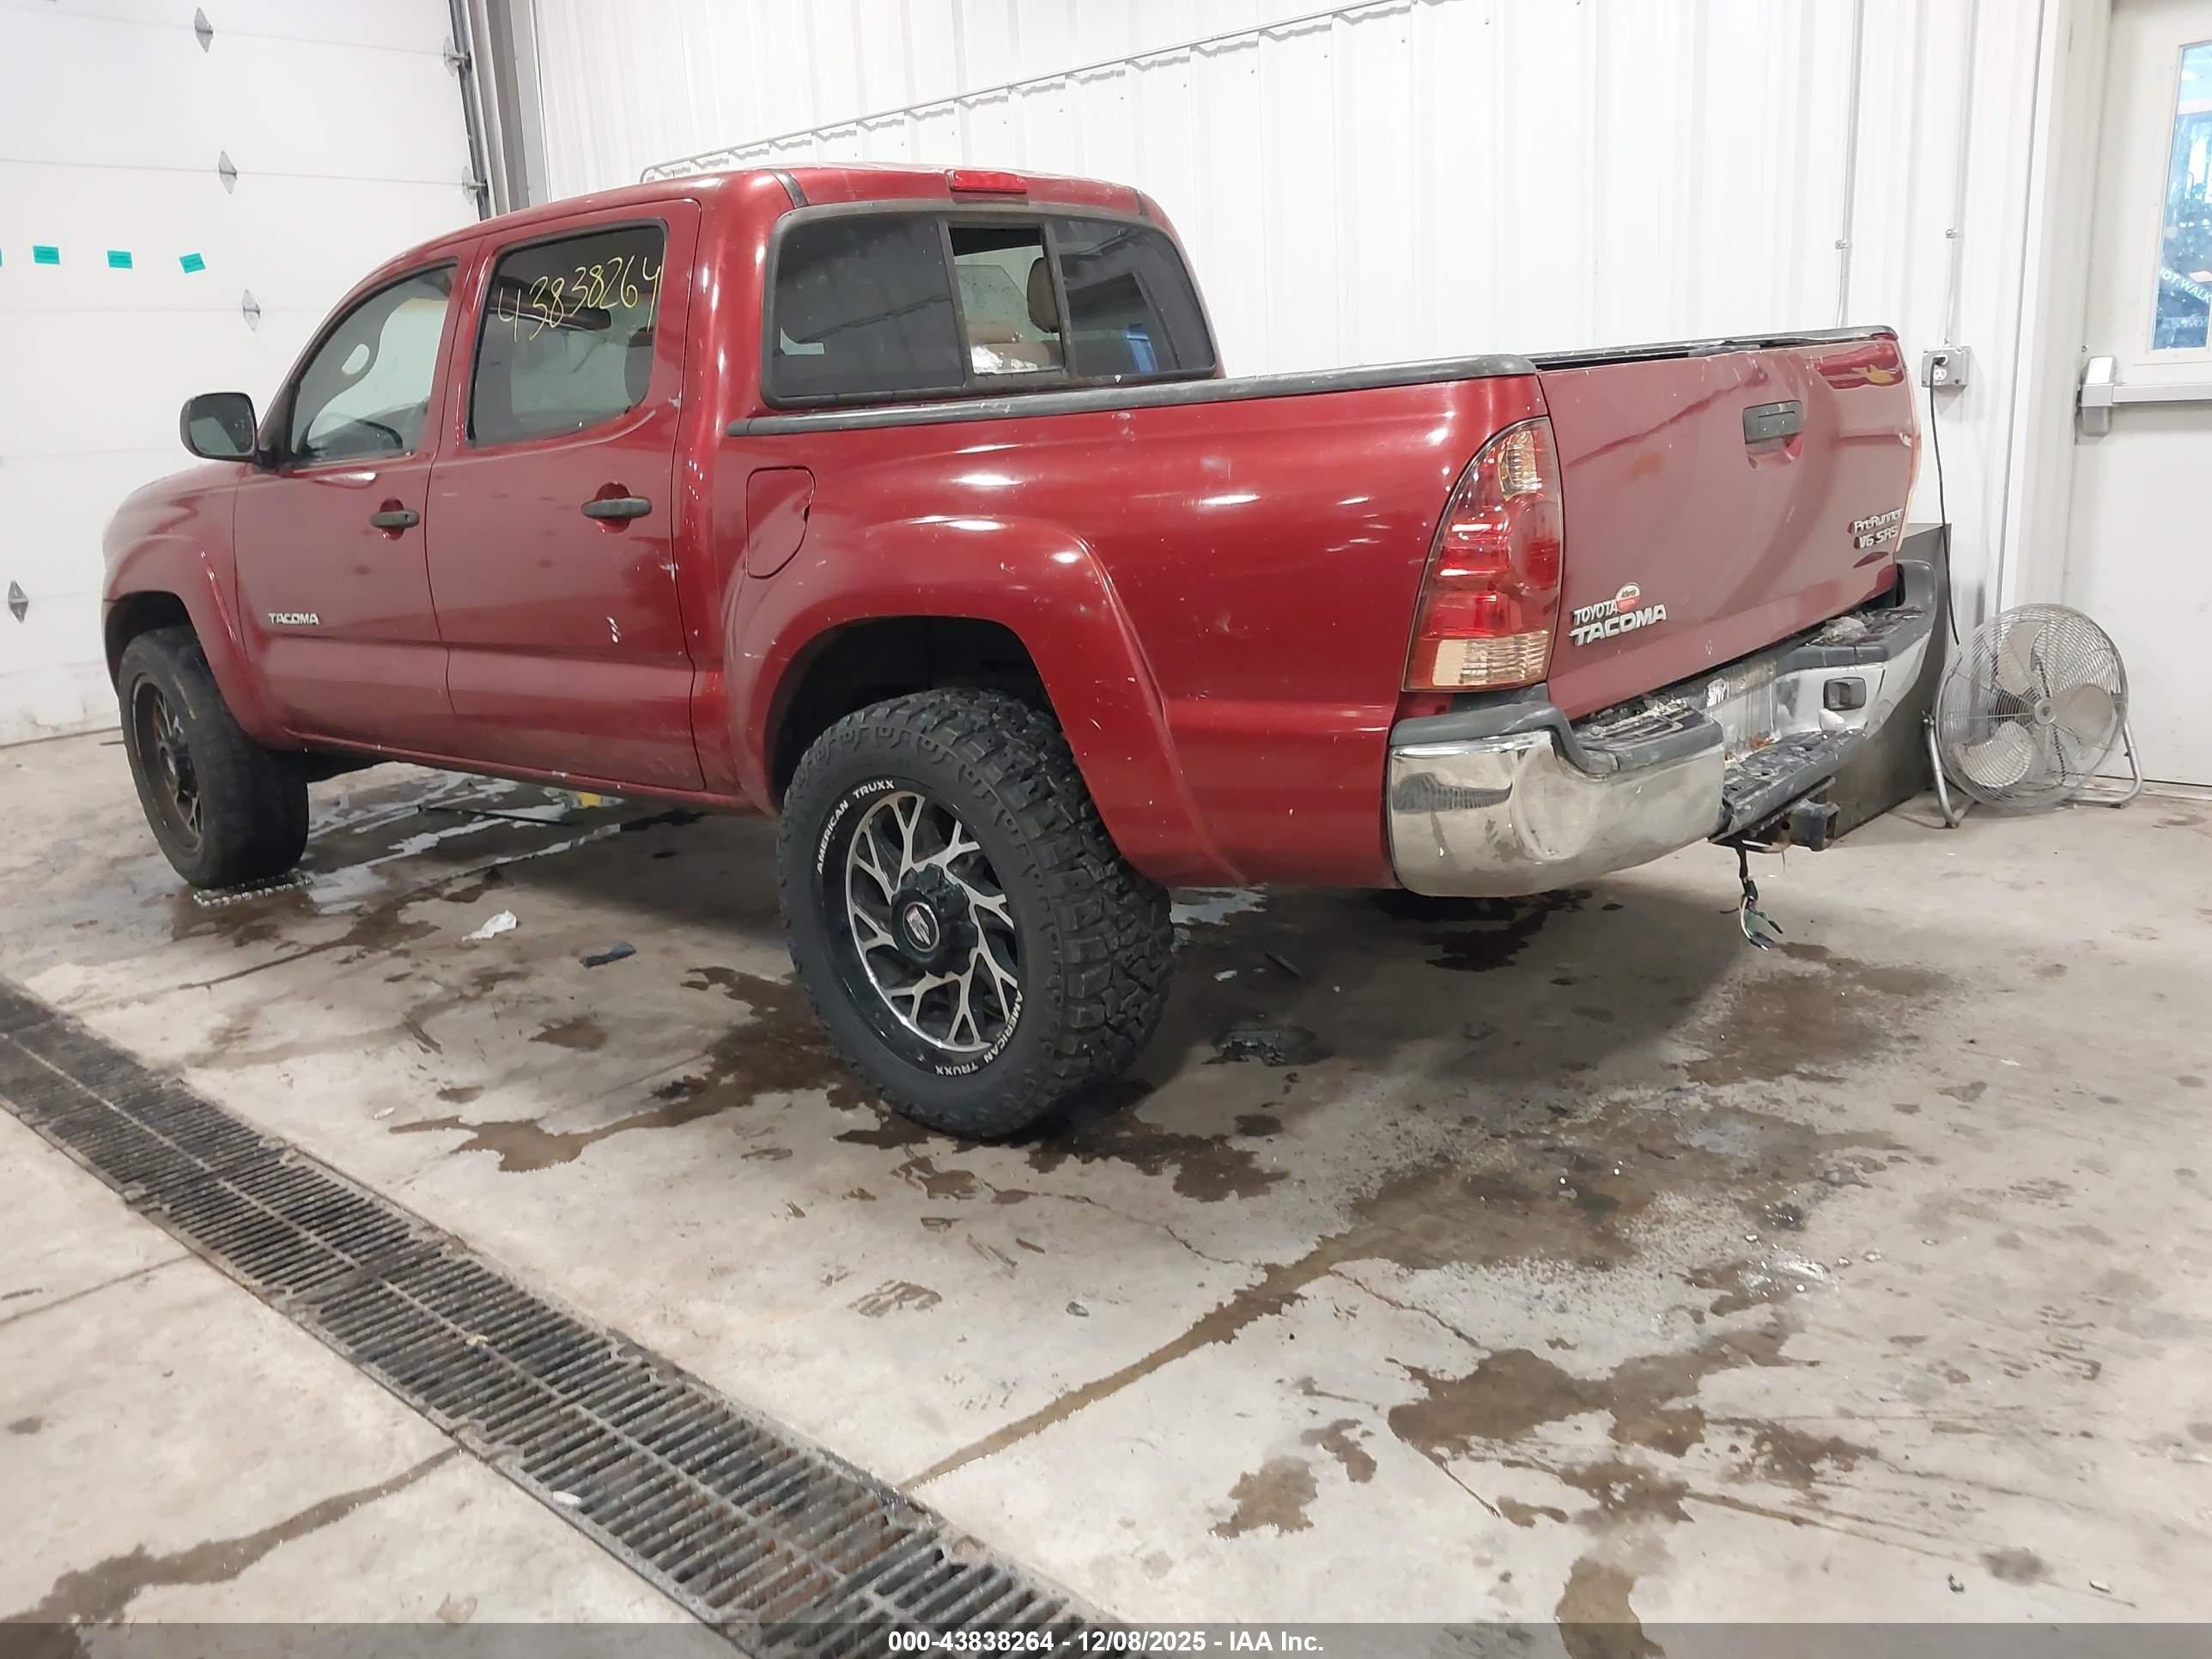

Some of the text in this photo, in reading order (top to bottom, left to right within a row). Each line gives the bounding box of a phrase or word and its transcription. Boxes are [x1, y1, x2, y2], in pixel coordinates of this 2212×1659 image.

[498, 255, 660, 343] 43838264
[2181, 279, 2212, 303] WALK
[1859, 533, 1875, 549] V6
[268, 612, 319, 625] TACOMA
[1569, 604, 1667, 646] TACOMA
[1574, 599, 1618, 626] TOYOTA
[817, 780, 895, 875] AMERICAN TRUXX
[934, 989, 1024, 1076] AMERICAN TRUXX
